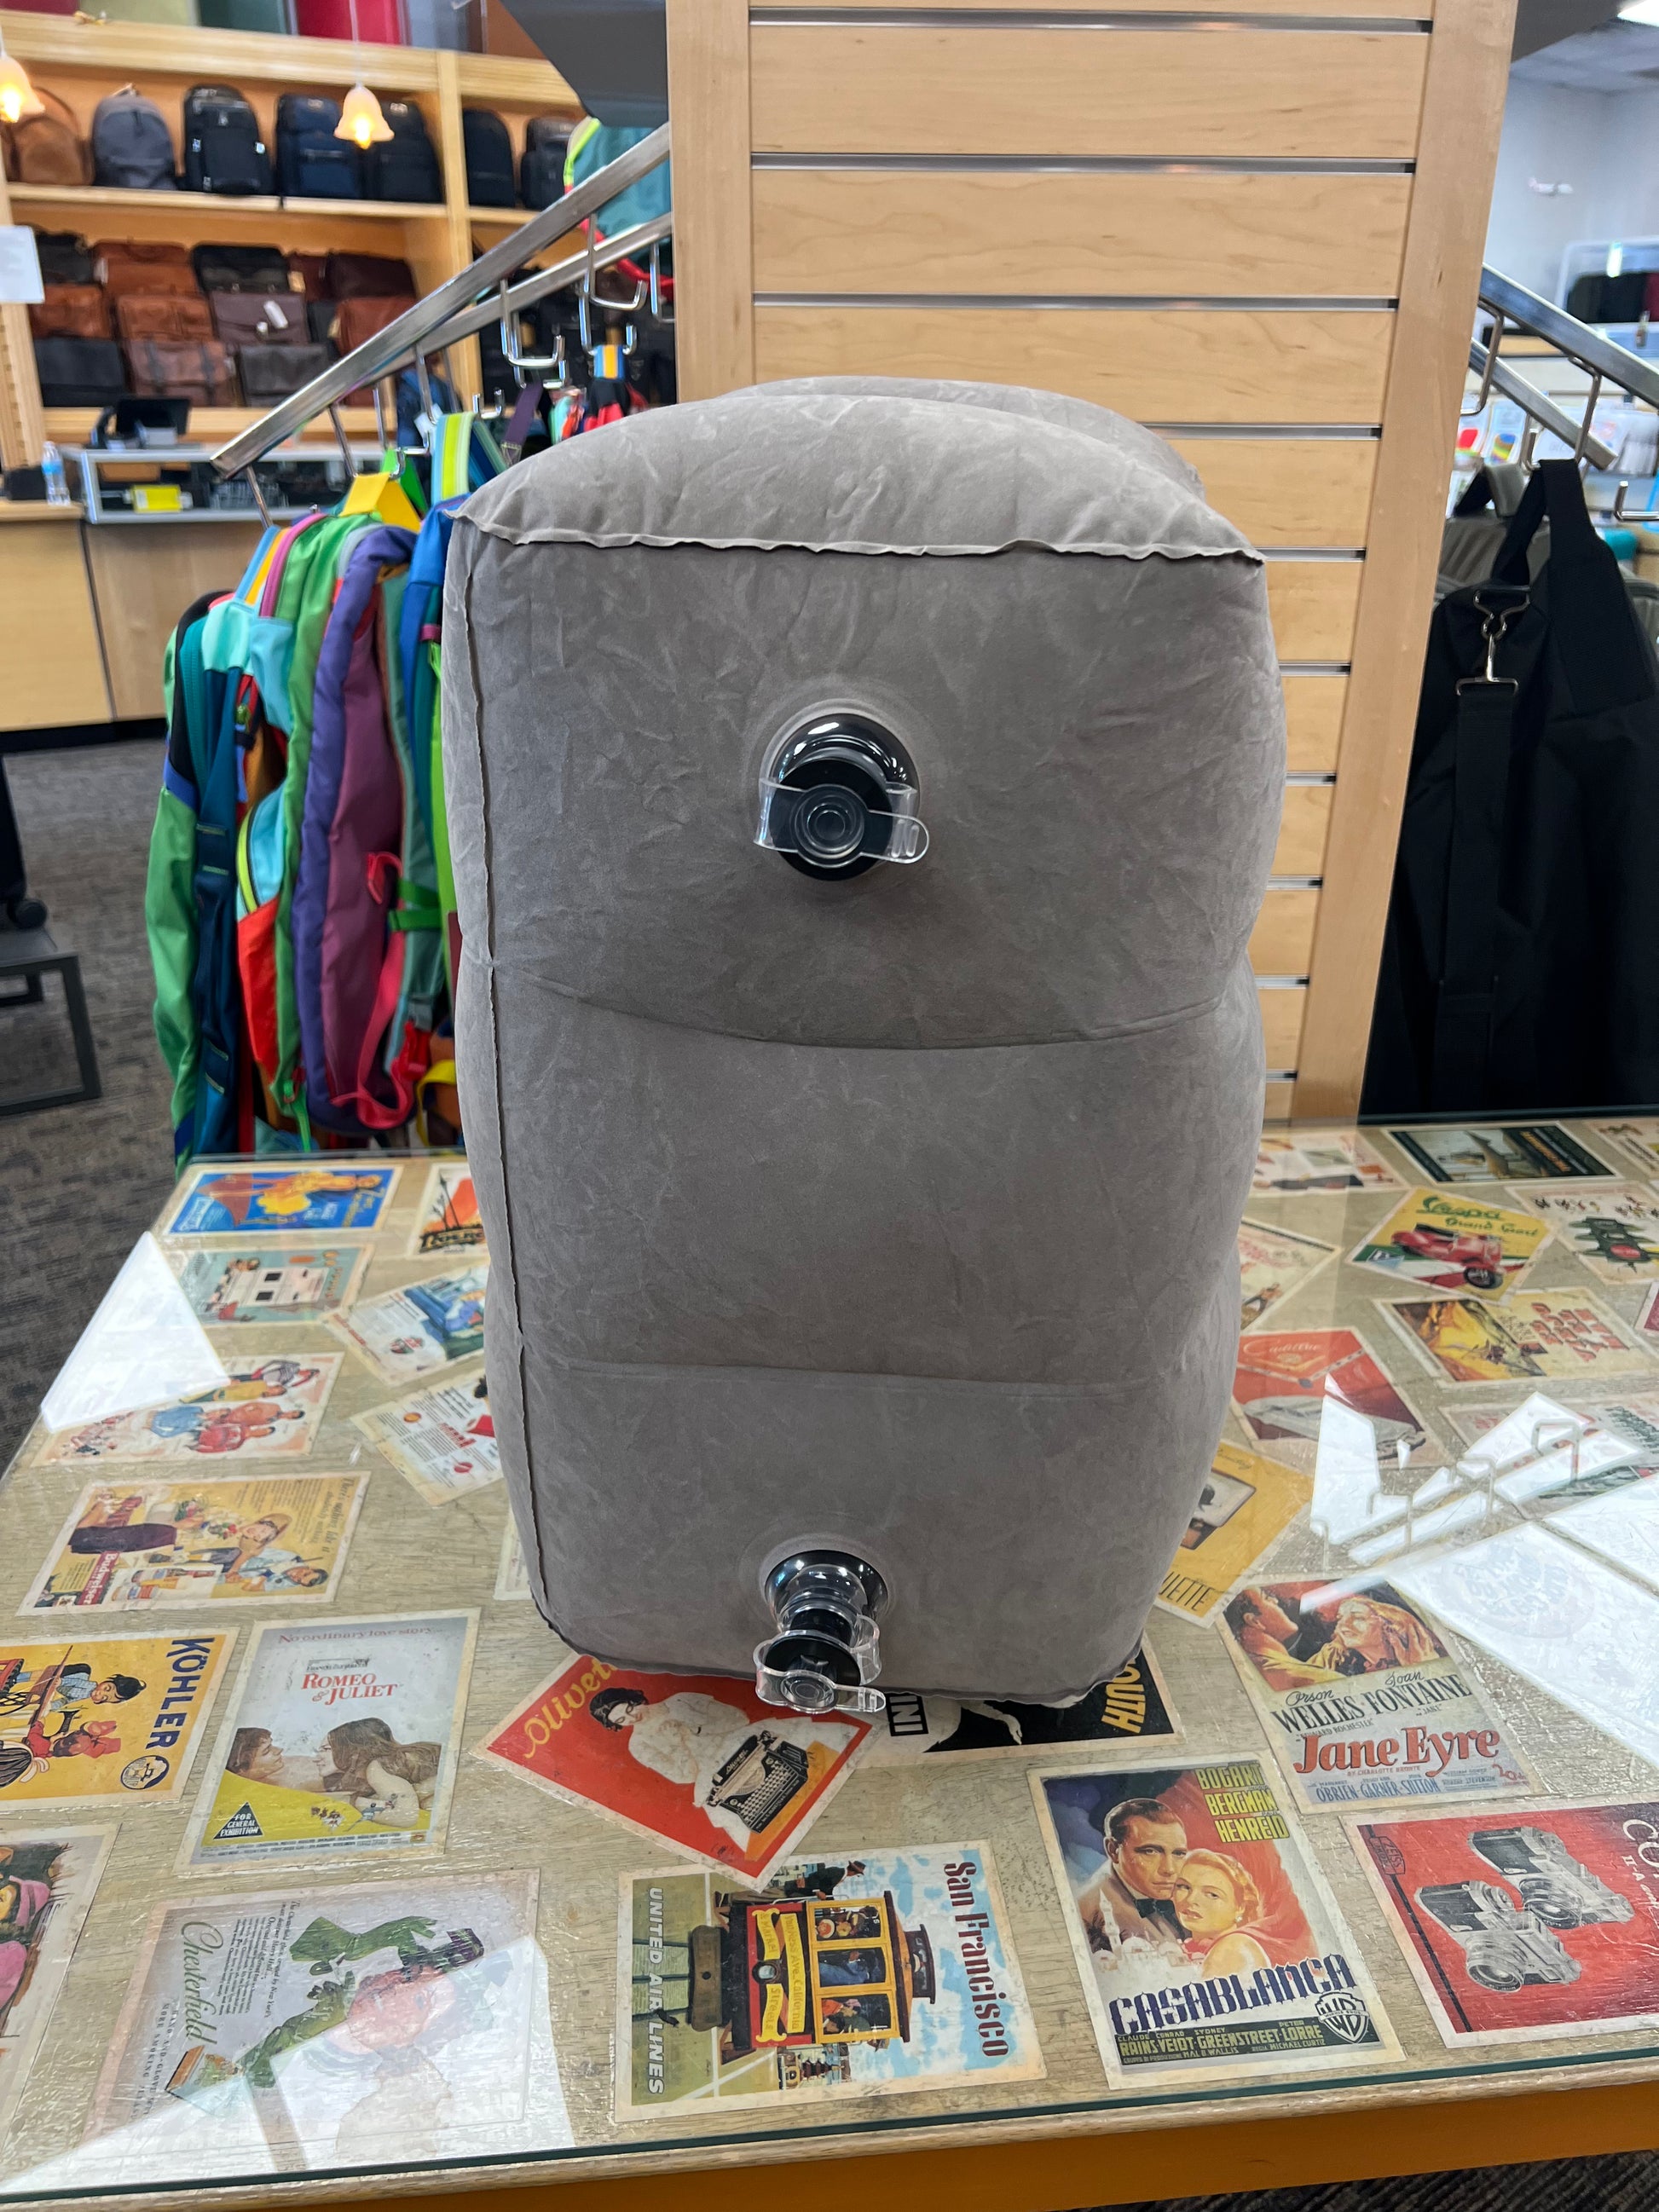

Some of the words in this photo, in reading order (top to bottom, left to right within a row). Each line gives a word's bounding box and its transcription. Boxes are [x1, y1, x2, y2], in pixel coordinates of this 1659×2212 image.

[1417, 1196, 1501, 1220] Vespa
[84, 1553, 118, 1605] Budweiser
[278, 1634, 298, 1644] No
[303, 1631, 364, 1642] ordinary
[146, 1637, 215, 1750] KÖHLER
[301, 1672, 377, 1689] ROMEO
[312, 1690, 330, 1702] &
[325, 1684, 398, 1706] JULIET
[1384, 1671, 1425, 1687] Joan
[523, 1657, 619, 1759] Olivet
[1101, 1659, 1146, 1734] OUTH
[1270, 1695, 1365, 1734] WELLES
[1361, 1673, 1474, 1715] FONTAINE
[1285, 1689, 1334, 1707] Orson
[1292, 1734, 1400, 1774] Jane
[1401, 1725, 1500, 1778] Eyre
[1194, 1763, 1266, 1790] BOGART
[1361, 1781, 1400, 1799] GARNER
[1401, 1778, 1441, 1795] SUTTON
[234, 1812, 251, 1822] FOR
[1204, 1789, 1279, 1816] BERGMAN
[219, 1828, 259, 1838] EXHIBITION
[227, 1820, 256, 1828] GENERAL
[1214, 1814, 1291, 1843] HENREID
[943, 1862, 976, 1906] San
[648, 1887, 664, 1965] UNITED
[760, 1920, 777, 1953] Market
[182, 1921, 224, 2045] Chesterfield
[648, 1975, 664, 2011] AIR
[955, 1912, 1010, 2057] Francisco
[1109, 1953, 1358, 2036] CASABLANCA
[765, 1987, 780, 2030] Streets
[792, 1979, 804, 2030] California
[1119, 2040, 1159, 2057] RAINS
[1159, 2036, 1195, 2053] VEIDT
[1196, 2028, 1279, 2050] GREENSTREET
[1280, 2024, 1324, 2045] LORRE
[1156, 2030, 1185, 2039] CONRAD
[1194, 2027, 1226, 2036] SYDNEY
[1269, 2041, 1302, 2051] MICHAEL
[1302, 2038, 1327, 2047] CURTIZ
[143, 2032, 162, 2078] SMOKING
[647, 2023, 665, 2094] LINES
[1208, 2047, 1240, 2056] WALLIS
